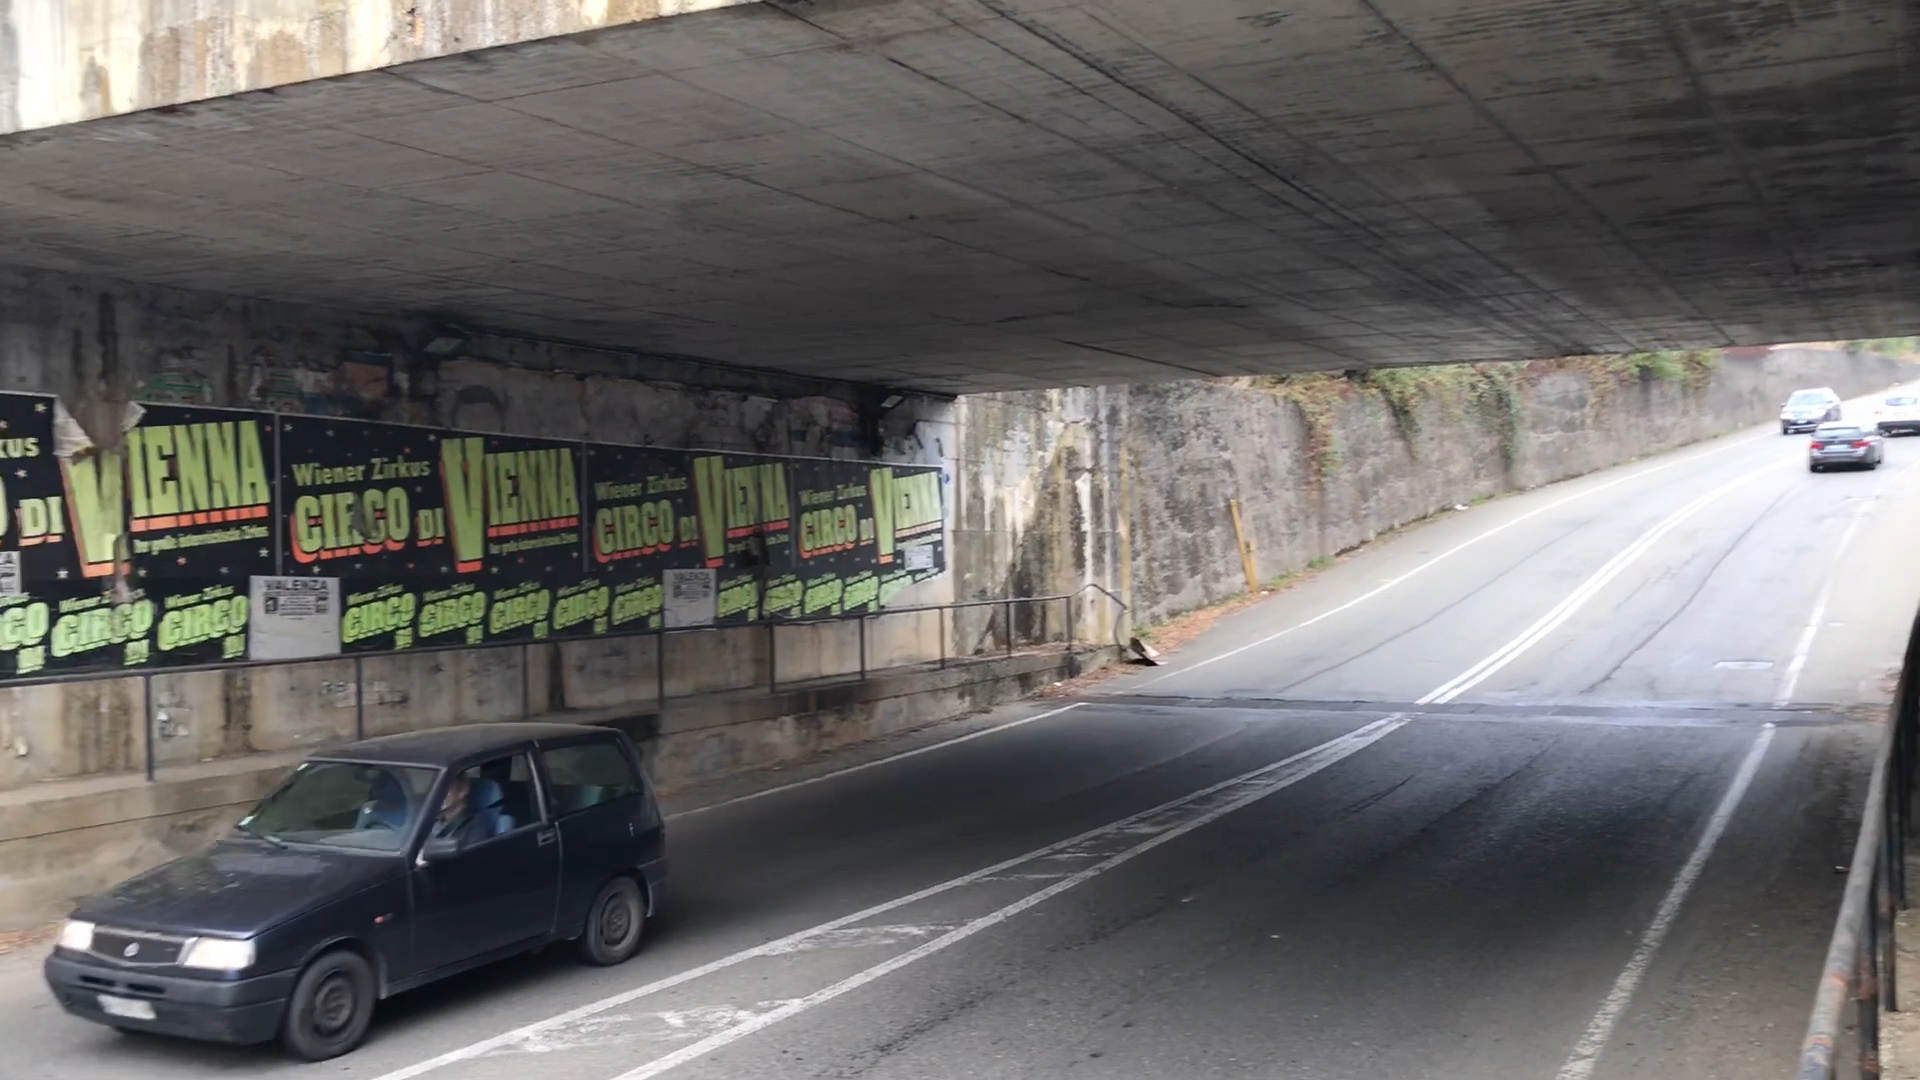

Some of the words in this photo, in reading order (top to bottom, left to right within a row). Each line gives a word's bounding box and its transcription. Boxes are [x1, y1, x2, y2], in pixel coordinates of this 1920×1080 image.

[18, 496, 65, 546] DI
[60, 419, 270, 578] VIENNA
[290, 487, 410, 562] CIRCO
[417, 507, 446, 546] DI
[440, 437, 580, 573] VIENNA
[291, 462, 365, 487] Wiener
[369, 455, 431, 480] Zirkus
[594, 499, 674, 562] CIRCO
[693, 455, 790, 568] VIENNA
[799, 505, 857, 559] CIRCO
[870, 467, 943, 564] VIENNA
[51, 599, 154, 657] CIRCO
[158, 595, 248, 651] CIRCO
[343, 593, 415, 643] CIRCO
